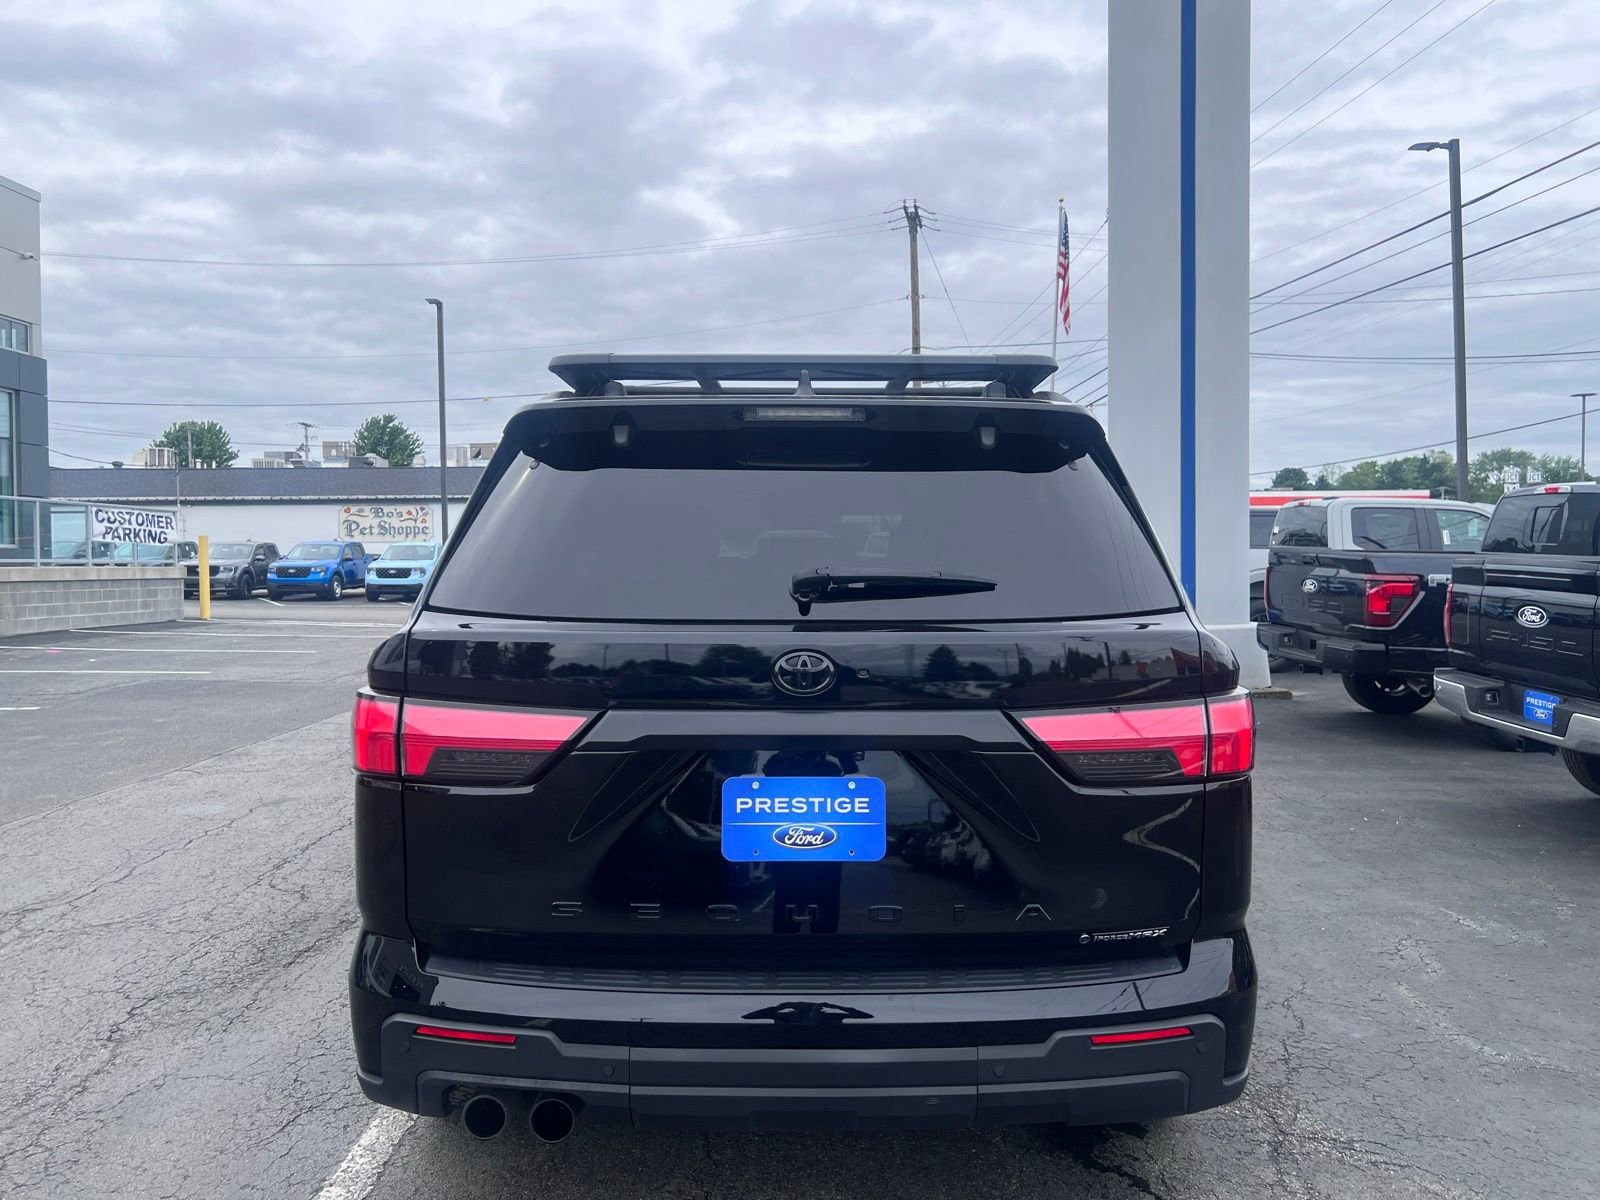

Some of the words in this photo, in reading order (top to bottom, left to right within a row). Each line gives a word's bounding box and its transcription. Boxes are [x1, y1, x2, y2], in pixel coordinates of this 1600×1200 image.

[1505, 473, 1518, 481] JCT
[1528, 473, 1541, 481] JCT
[94, 508, 174, 530] CUSTOMER
[370, 507, 403, 518] Bo's
[102, 526, 168, 544] PARKING
[342, 519, 374, 537] Pet
[376, 520, 429, 538] Shoppe
[1522, 609, 1541, 622] Ford
[736, 797, 870, 813] PRESTIGE
[784, 825, 824, 845] Ford
[551, 900, 1052, 923] SEQUOIA
